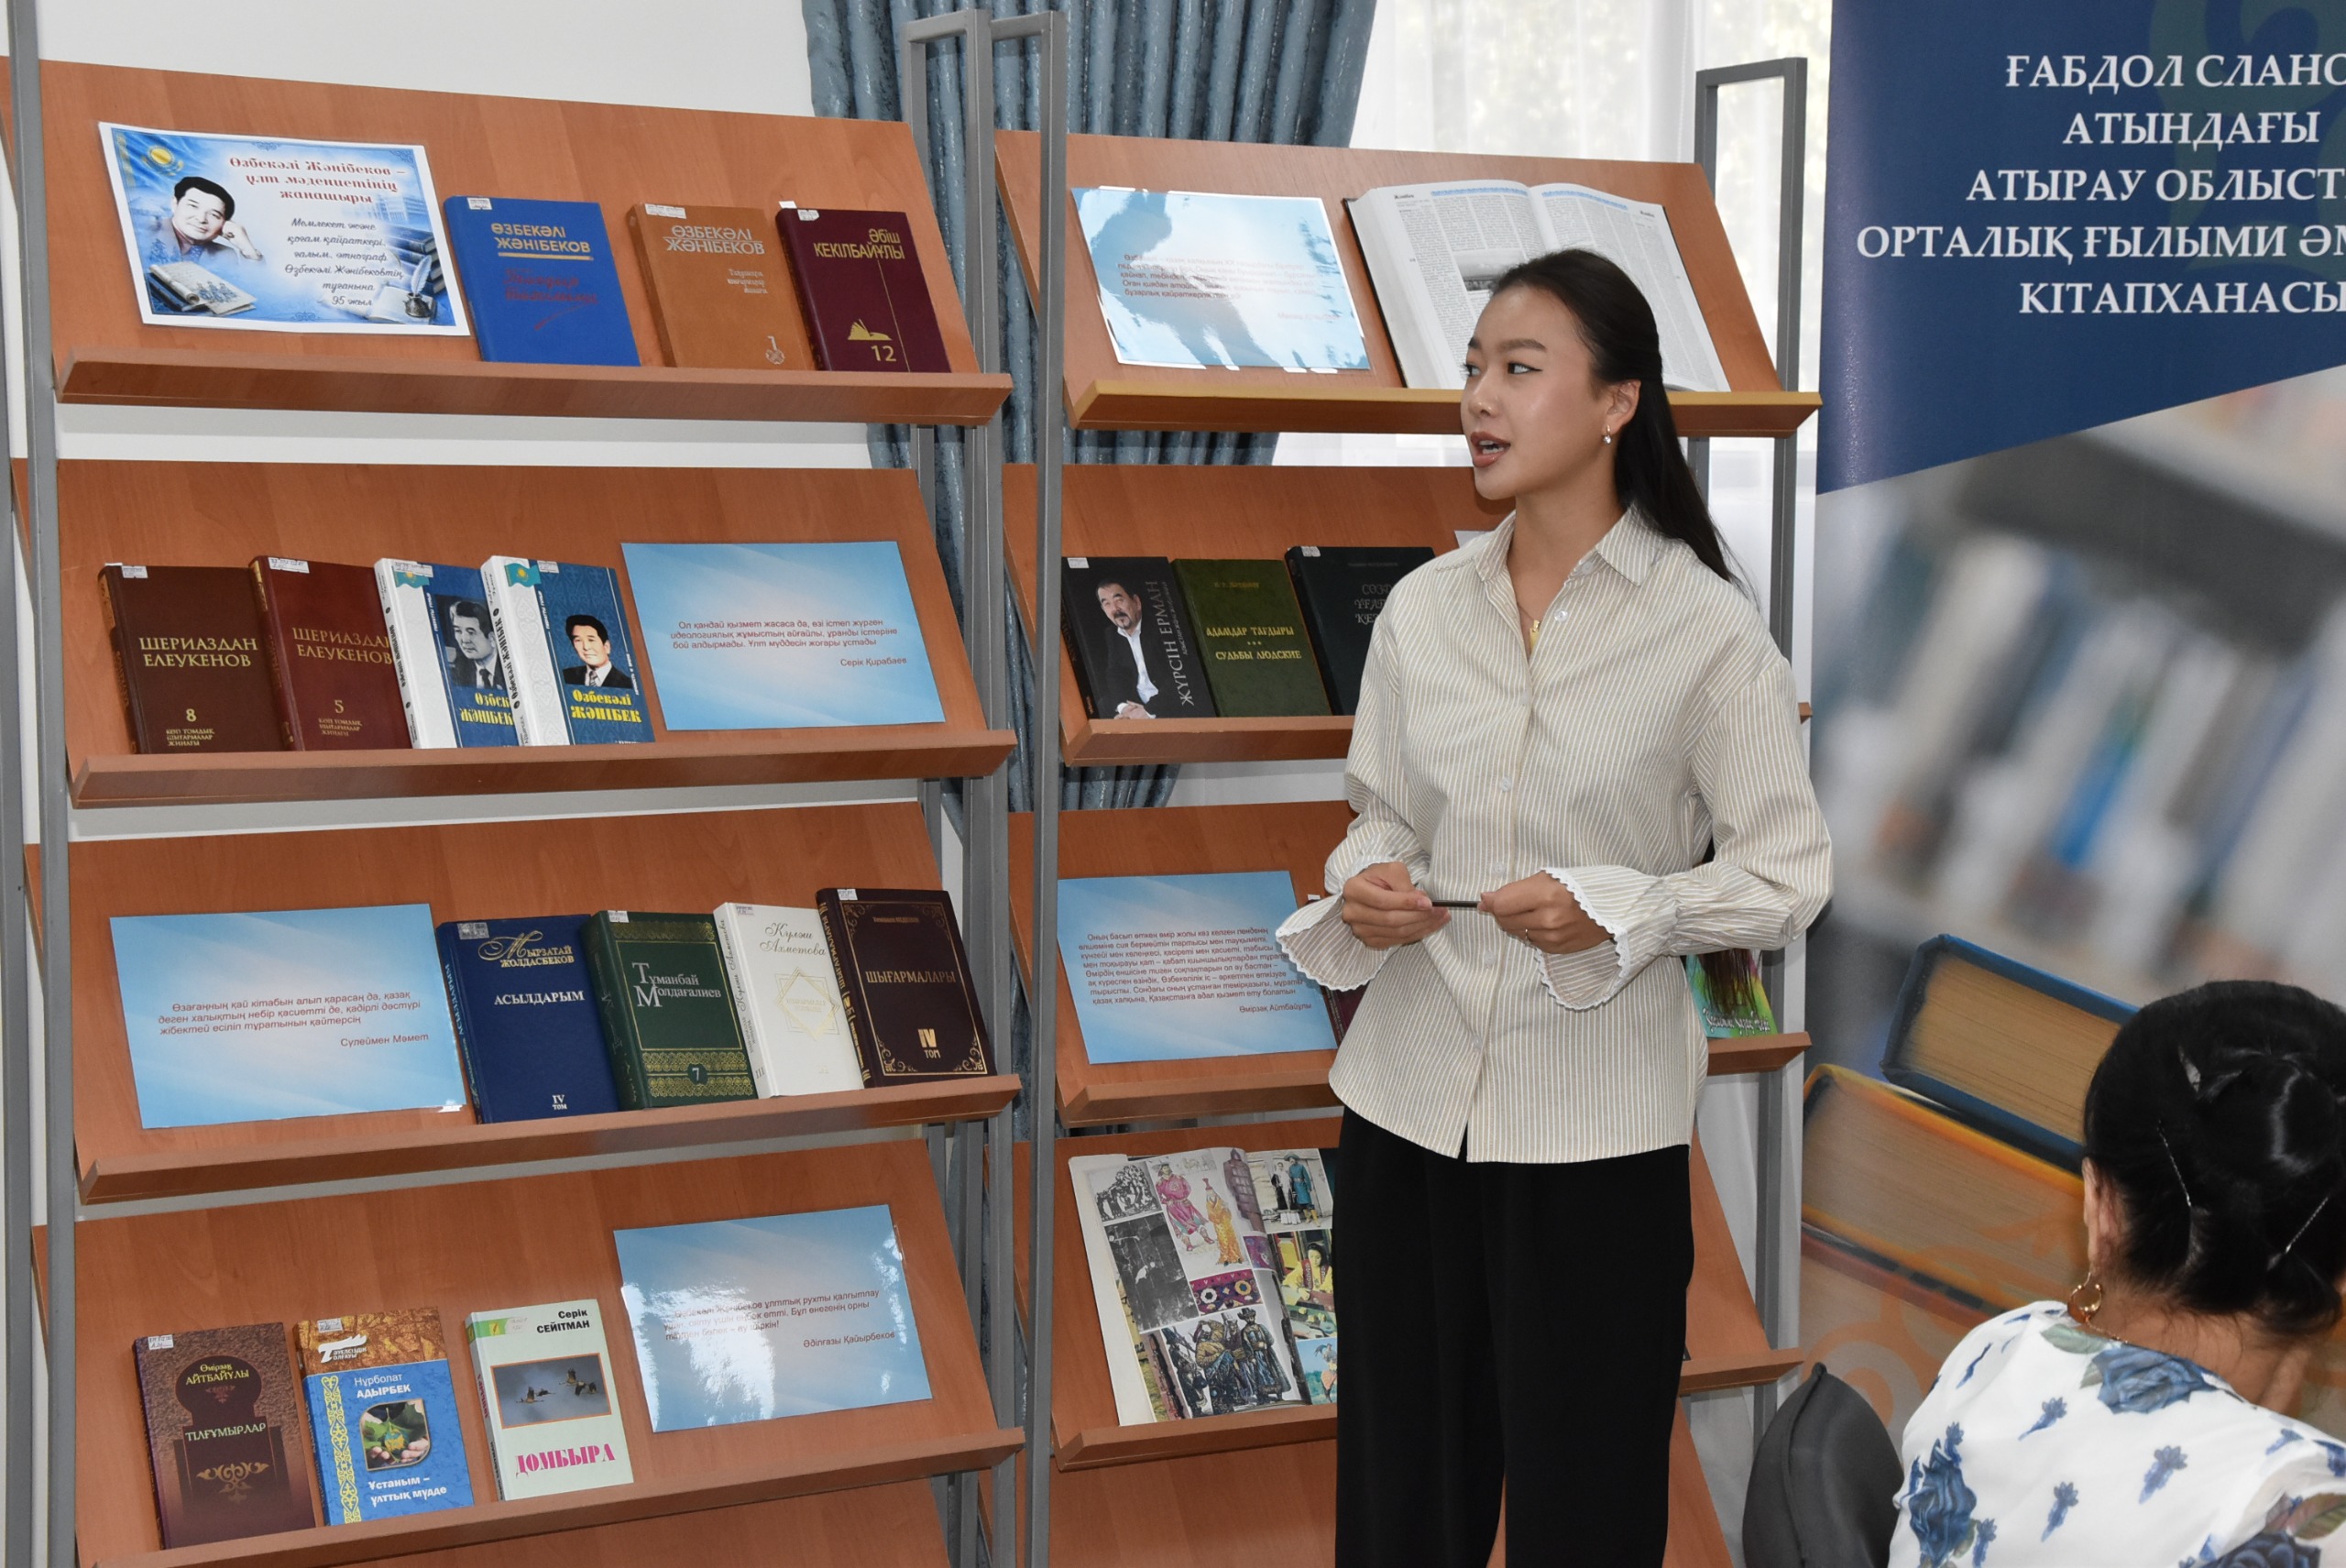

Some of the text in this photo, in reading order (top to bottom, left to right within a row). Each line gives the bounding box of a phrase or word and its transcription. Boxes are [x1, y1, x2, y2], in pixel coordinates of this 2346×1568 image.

[2005, 54, 2346, 94] ҒАБДОЛ СЛАНО
[2063, 112, 2320, 151] АТЫНДАҒЫ
[230, 158, 391, 175] Өзбекәлі Жәнібеков
[1966, 169, 2346, 202] АТЫРАУ ОБЛЫСТ
[280, 191, 372, 204] жанашыры
[491, 223, 566, 237] ӨЗБЕКӘЛІ
[672, 225, 752, 240] ӨЗБЕКӘЛІ
[869, 228, 900, 243] Әбіш
[494, 236, 591, 252] ЖӘНІБЕКОВ
[664, 237, 765, 254] ЖӘНІБЕКОВ
[814, 242, 905, 259] КЕКІЛБАЙҰЛЫ
[1857, 225, 2072, 265] ОРТАЛЫҚ
[2083, 225, 2287, 258] ҒЫЛЫМИ
[332, 296, 345, 304] 95
[2019, 281, 2346, 313] КІТАПХАНАСЫ
[872, 345, 897, 361] 12
[1146, 581, 1173, 635] ЕРМАН
[139, 638, 258, 651] ШЕРИАЗДАН
[143, 654, 251, 667] ЕЛЕУКЕНОВ
[297, 644, 392, 664] ЕЛЕУКЕНОВ
[1216, 651, 1301, 660] СУДЬБЫ ЛЮДСКИЕ
[840, 659, 863, 667] Серік
[1164, 641, 1194, 706] ЖҮРСІН
[573, 689, 631, 706] Өзбекәлі
[334, 700, 345, 713] 5
[186, 708, 196, 721] 8
[571, 707, 641, 722] ЖӘНІБЕК
[760, 938, 826, 955] Ахметова
[500, 955, 575, 968] ЖОЛДАСБЕКОВ
[865, 970, 956, 983] ШЫҒАРМАЛАРЫ
[231, 1000, 248, 1010] қай
[251, 998, 293, 1007] кітабын
[324, 994, 365, 1004] қарасаң
[384, 992, 411, 1001] қазақ
[494, 991, 585, 1005] АСЫЛДАРЫМ
[633, 985, 721, 1008] Молдағалиев
[158, 1015, 188, 1024] деген
[192, 1012, 246, 1022] халықтың
[159, 1024, 210, 1036] жібектей
[310, 1015, 361, 1026] қайтерсің
[918, 1029, 937, 1047] IV
[924, 1049, 940, 1058] ТОМ
[692, 1068, 699, 1080] 7
[553, 1095, 565, 1103] IV
[803, 1295, 830, 1305] рухты
[558, 1310, 587, 1320] Серік
[537, 1321, 589, 1333] СЕЙІТМАН
[355, 1375, 402, 1387] Нұрболат
[357, 1385, 411, 1398] АДЫРБЕК
[516, 1443, 616, 1478] ДОМБЫРА
[368, 1476, 421, 1489] Ұстаным
[371, 1486, 447, 1508] ұлттық мүдде
